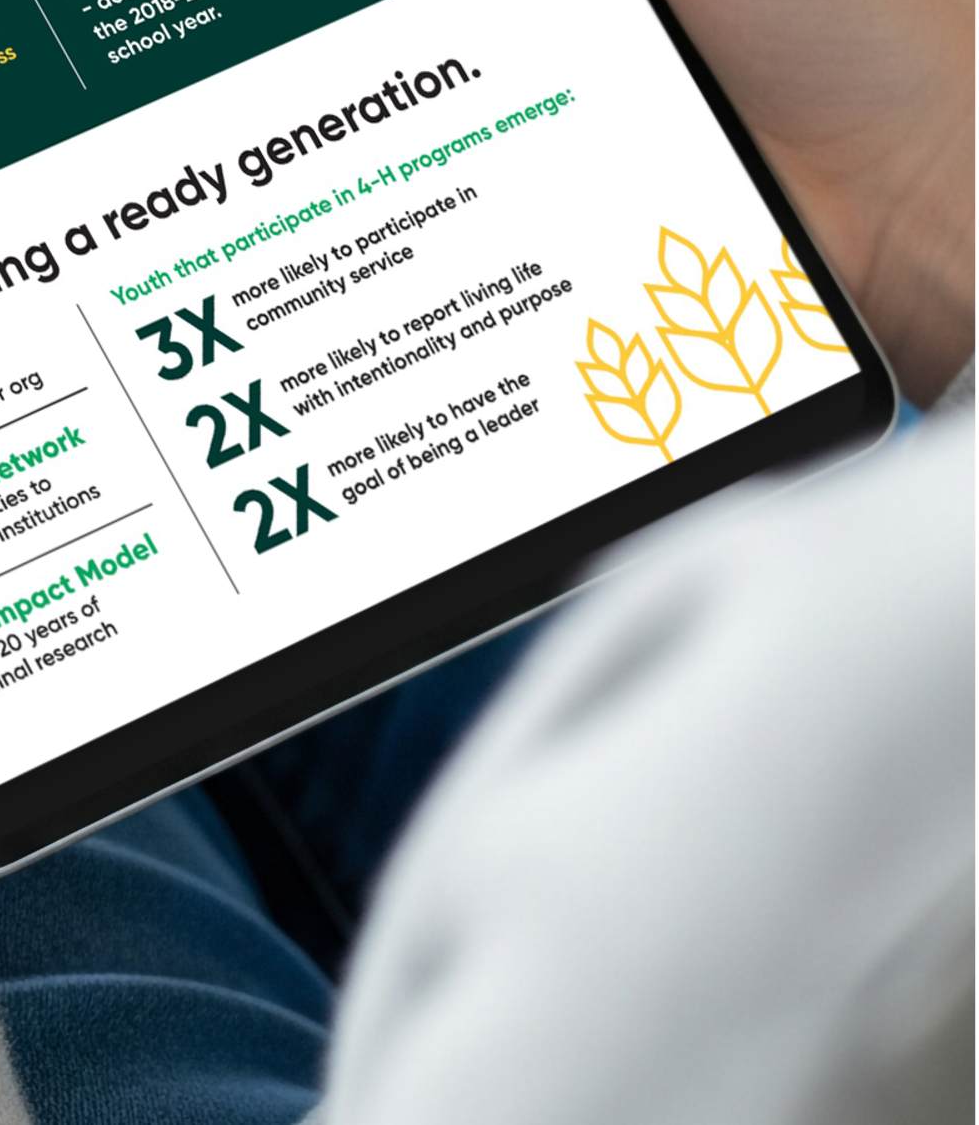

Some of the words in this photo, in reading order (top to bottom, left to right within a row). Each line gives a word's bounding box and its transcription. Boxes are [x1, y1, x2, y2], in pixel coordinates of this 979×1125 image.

[93, 18, 128, 39] the
[108, 23, 171, 63] school
[172, 7, 222, 39] year.
[65, 224, 98, 256] a
[102, 163, 227, 240] ready
[238, 59, 481, 187] generation.
[110, 270, 172, 305] Youth
[173, 248, 220, 278] that
[221, 199, 332, 262] participate
[332, 189, 355, 206] in
[358, 165, 397, 194] 4-H
[398, 127, 493, 182] programs
[495, 89, 575, 133] emerge:
[232, 277, 280, 307] more
[279, 254, 329, 284] likely
[331, 244, 353, 260] to
[355, 197, 456, 255] participate
[456, 187, 477, 203] in
[247, 276, 346, 330] community
[349, 247, 414, 284] service
[135, 294, 245, 381] 3X
[280, 363, 328, 392] more
[327, 339, 377, 369] likely
[379, 329, 401, 345] to
[403, 299, 461, 335] report
[460, 277, 513, 308] living
[511, 262, 542, 284] life
[293, 389, 335, 416] with
[334, 332, 456, 397] intentionality
[460, 311, 497, 339] and
[498, 280, 572, 325] purpose
[10, 372, 44, 394] org
[185, 379, 291, 469] 2X
[327, 447, 376, 477] more
[375, 422, 424, 453] likely
[426, 413, 448, 429] to
[448, 390, 496, 419] have
[498, 374, 530, 395] the
[29, 479, 51, 495] to
[342, 468, 385, 505] goal
[387, 458, 406, 479] of
[406, 437, 464, 470] being
[465, 429, 479, 443] a
[478, 399, 539, 436] leader
[233, 463, 339, 555] 2X
[74, 532, 158, 587] Model
[24, 611, 78, 648] years
[81, 595, 100, 617] of
[35, 622, 118, 670] research
